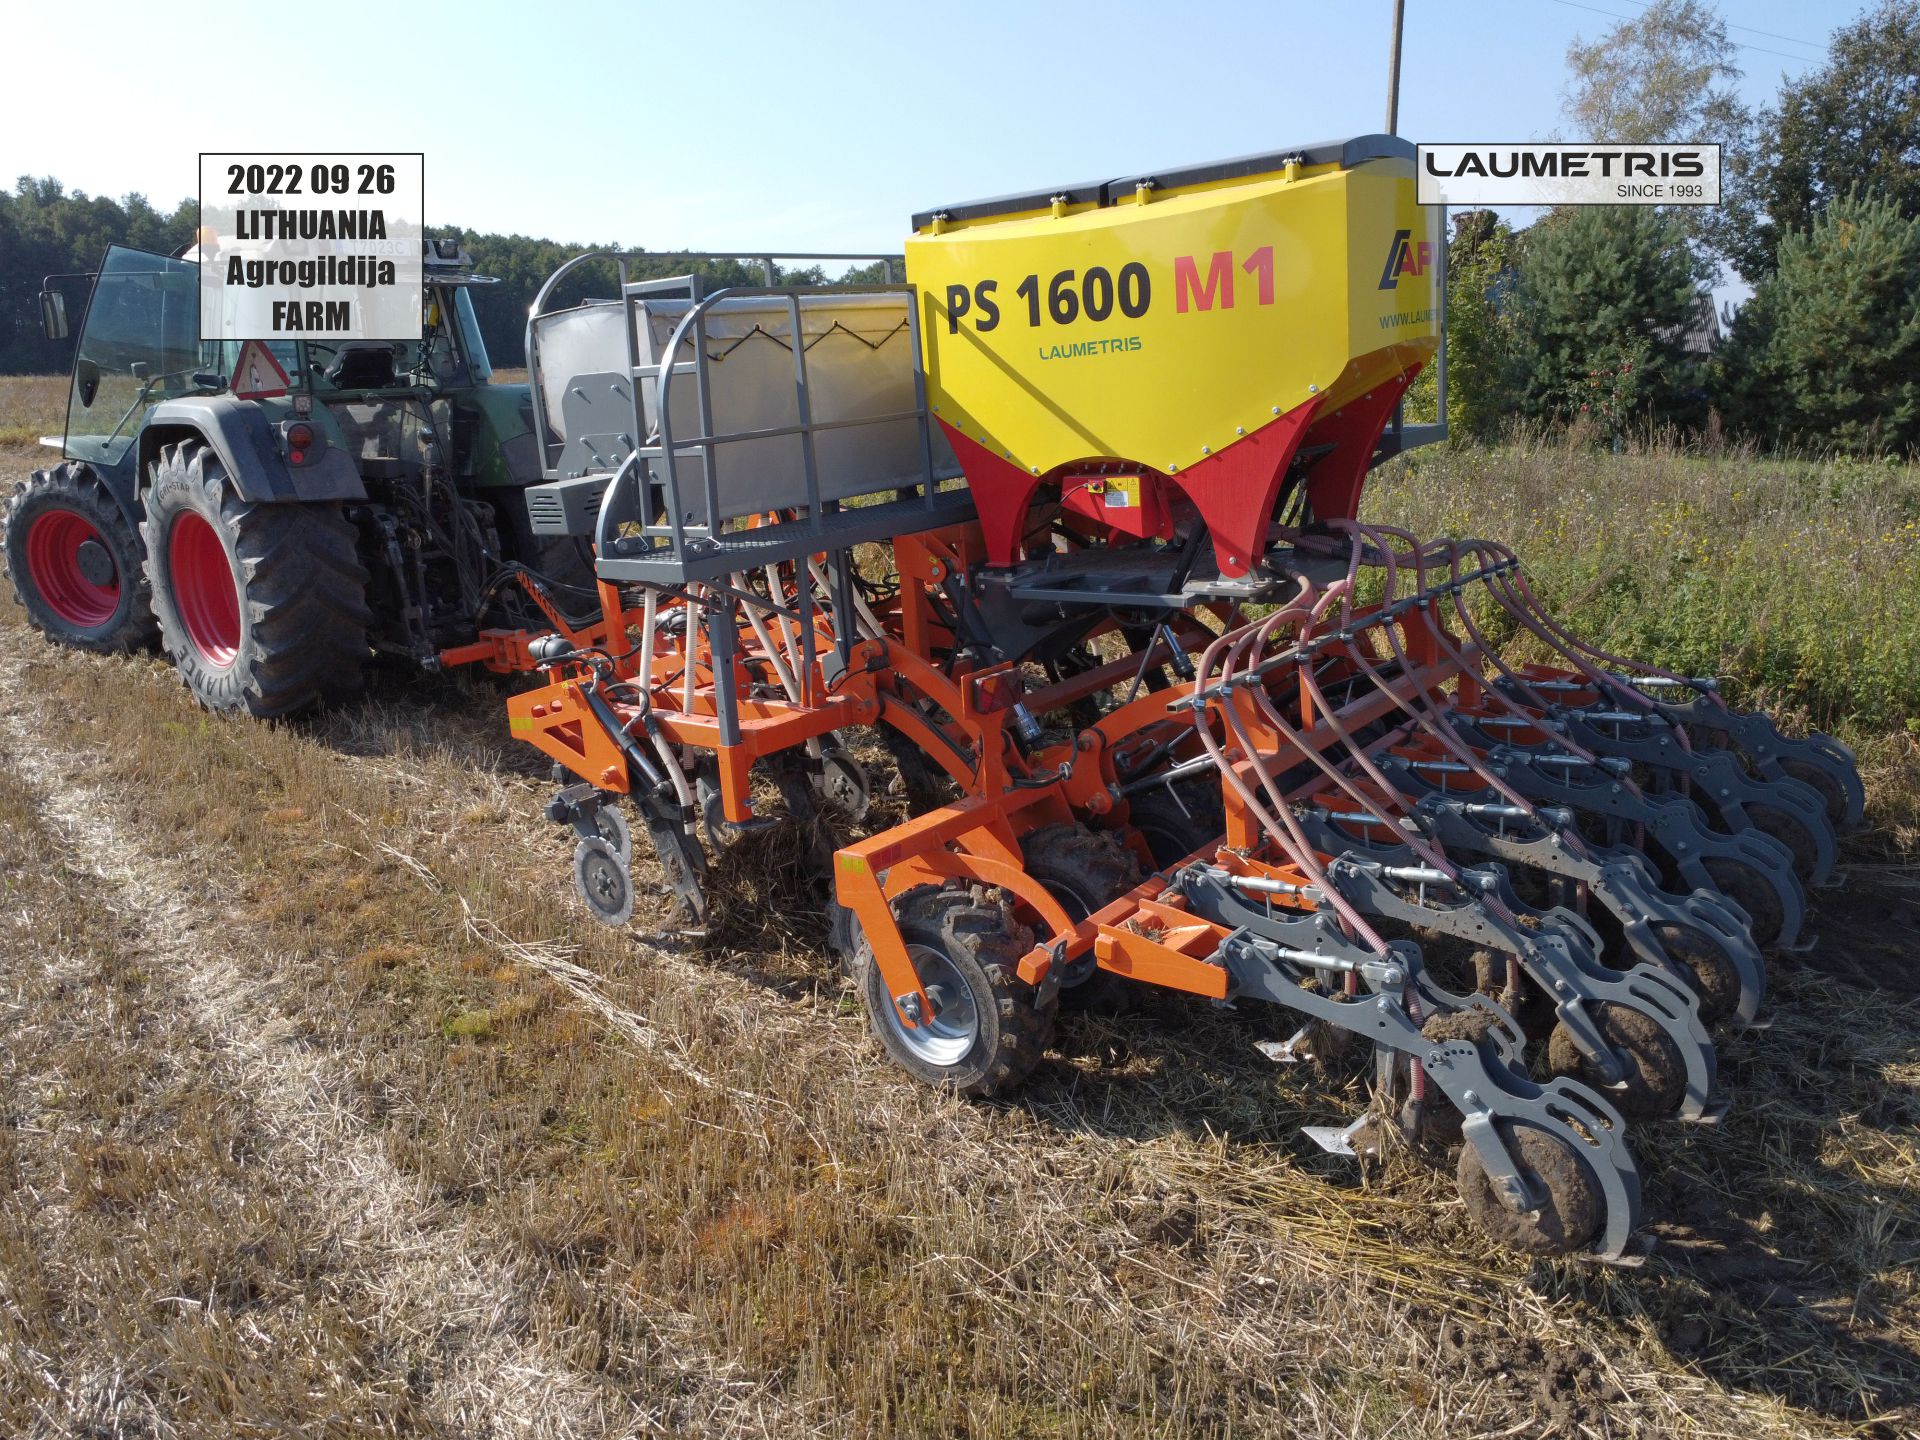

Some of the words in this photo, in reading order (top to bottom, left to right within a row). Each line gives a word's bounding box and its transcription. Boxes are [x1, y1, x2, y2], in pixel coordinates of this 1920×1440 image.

[946, 279, 1000, 335] PS
[1016, 261, 1151, 328] 1600
[1039, 336, 1142, 361] LAUMETRIS
